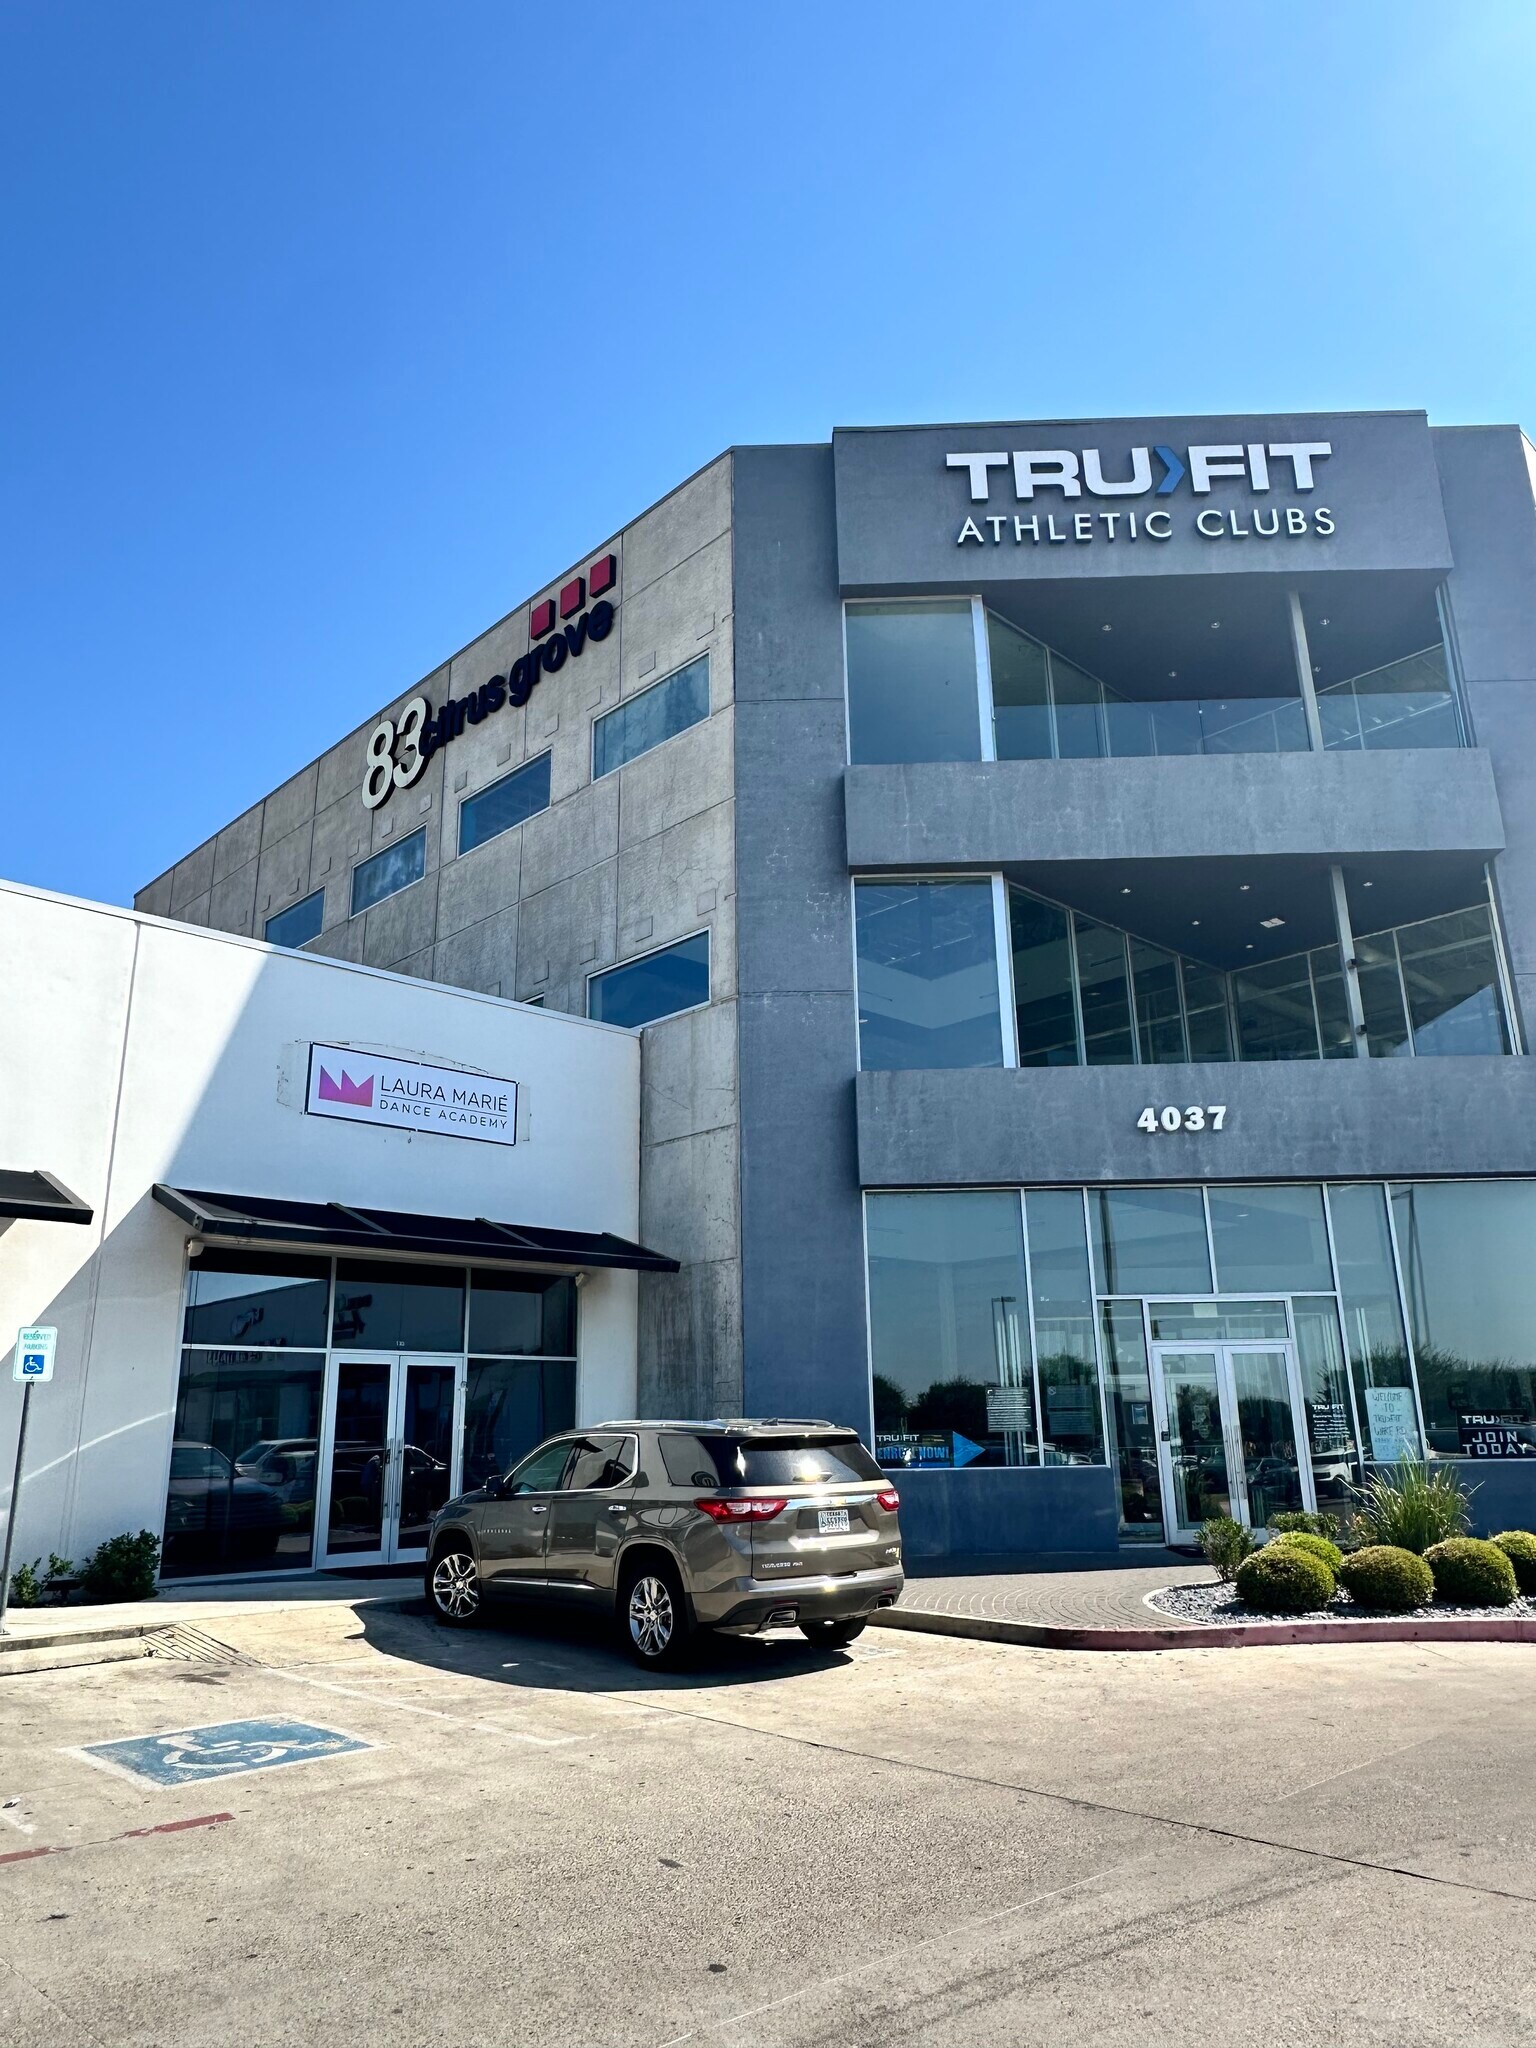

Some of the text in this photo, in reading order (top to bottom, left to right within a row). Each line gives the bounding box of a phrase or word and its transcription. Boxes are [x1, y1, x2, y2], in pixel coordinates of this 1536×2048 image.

[957, 507, 1336, 545] ATHLETIC CLUBS
[508, 600, 614, 707] grove
[361, 697, 430, 810] 83
[381, 1075, 446, 1102] LAURA
[380, 1100, 508, 1129] DANCE ACADEMY
[1137, 1106, 1227, 1132] 4037
[1384, 1403, 1394, 1412] TO
[1462, 1443, 1528, 1455] TODAY
[1472, 1431, 1518, 1443] JOIN
